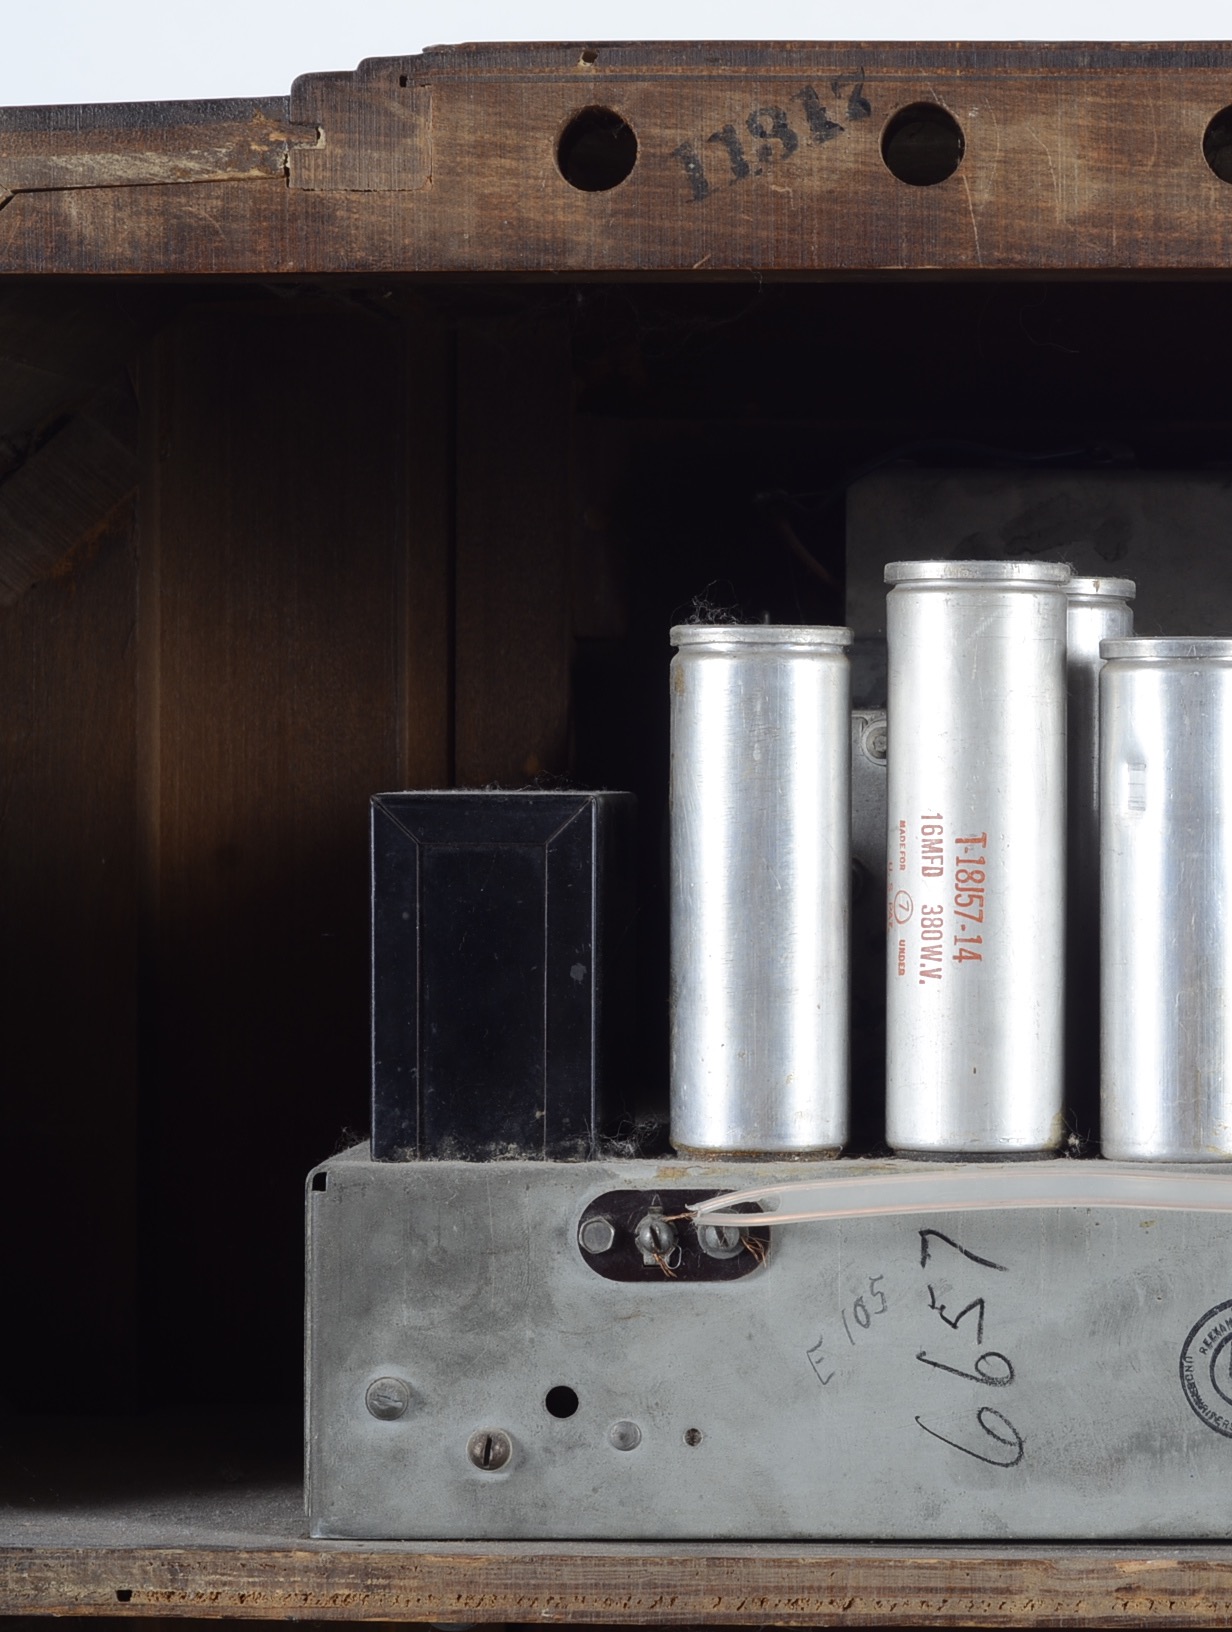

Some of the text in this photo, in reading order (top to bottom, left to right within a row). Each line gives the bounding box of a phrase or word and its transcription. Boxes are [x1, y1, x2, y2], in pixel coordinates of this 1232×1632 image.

[920, 813, 943, 877] 16MFD
[952, 832, 987, 963] T-18J57-14
[898, 939, 906, 976] UNDER
